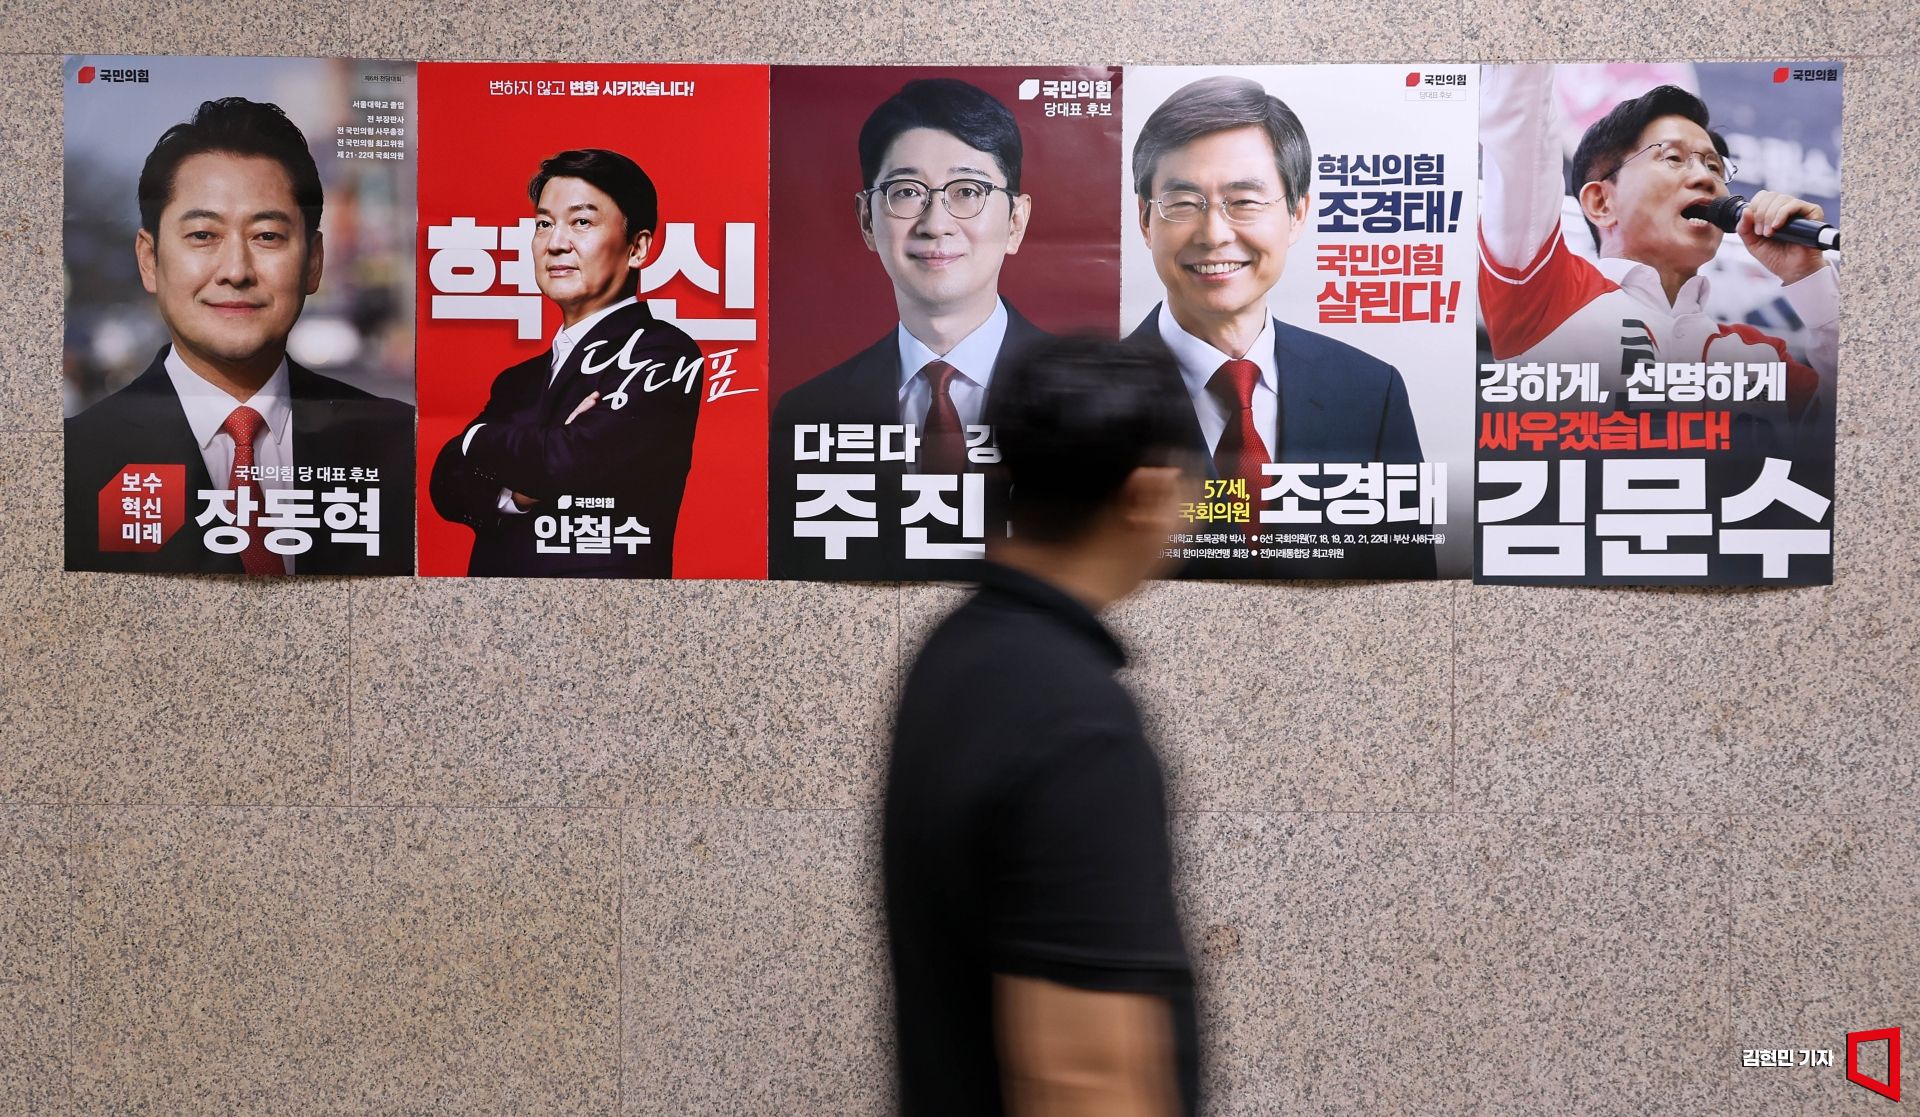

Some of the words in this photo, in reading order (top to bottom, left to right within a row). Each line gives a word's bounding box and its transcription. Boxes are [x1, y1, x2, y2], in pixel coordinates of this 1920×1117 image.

[100, 69, 149, 83] 국민의힘
[1424, 74, 1467, 86] 국민의힘
[1793, 69, 1837, 81] 국민의힘
[489, 80, 532, 96] 변하지
[536, 80, 565, 96] 않고
[569, 80, 599, 96] 변화
[602, 80, 695, 97] 시키겠습니다!
[1042, 80, 1112, 99] 국민의힘
[352, 100, 389, 109] 서울대학교
[1044, 102, 1082, 117] 당대표
[1086, 102, 1112, 117] 후보
[375, 115, 404, 124] 부장판사
[337, 126, 344, 135] 전
[345, 127, 374, 135] 국민의힘
[337, 139, 344, 147] 전
[345, 139, 374, 147] 국민의힘
[375, 139, 404, 148] 최고위원
[375, 152, 404, 160] 국회의원
[1317, 153, 1445, 187] 혁신의힘
[1317, 190, 1463, 234] 조경태!
[1316, 243, 1443, 277] 국민의힘
[428, 217, 757, 341] 혁신
[1316, 280, 1461, 324] 살린다!
[580, 328, 759, 410] 당대표
[1480, 362, 1610, 404] 강하게,
[1626, 362, 1787, 402] 선명하게
[1479, 411, 1731, 451] 싸우겠습니다!
[794, 423, 921, 463] 다르다
[121, 473, 162, 494] 보수
[235, 466, 294, 482] 국민의힘
[298, 466, 313, 482] 당
[316, 466, 346, 483] 대표
[349, 467, 380, 483] 후보
[1204, 478, 1251, 501] 57세,
[1259, 462, 1448, 525] 조경태
[121, 497, 162, 519] 혁신
[575, 497, 615, 509] 국민의힘
[1178, 502, 1251, 523] 국회의원
[195, 486, 380, 557] 장동혁
[793, 472, 1014, 560] 주진
[1478, 456, 1832, 579] 김문수
[121, 522, 162, 545] 미래
[534, 514, 651, 555] 안철수
[1195, 533, 1228, 544] 토목공학
[1229, 533, 1246, 544] 박사
[1259, 533, 1274, 544] 6선
[1319, 534, 1330, 545] 18,
[1331, 534, 1342, 545] 19,
[1343, 534, 1356, 545] 20,
[1358, 534, 1369, 545] 21,
[1370, 534, 1388, 544] 22대
[1393, 533, 1410, 545] 부산
[1183, 548, 1230, 559] 한미의원연맹
[1232, 548, 1249, 559] 회장
[1312, 548, 1345, 559] 최고위원
